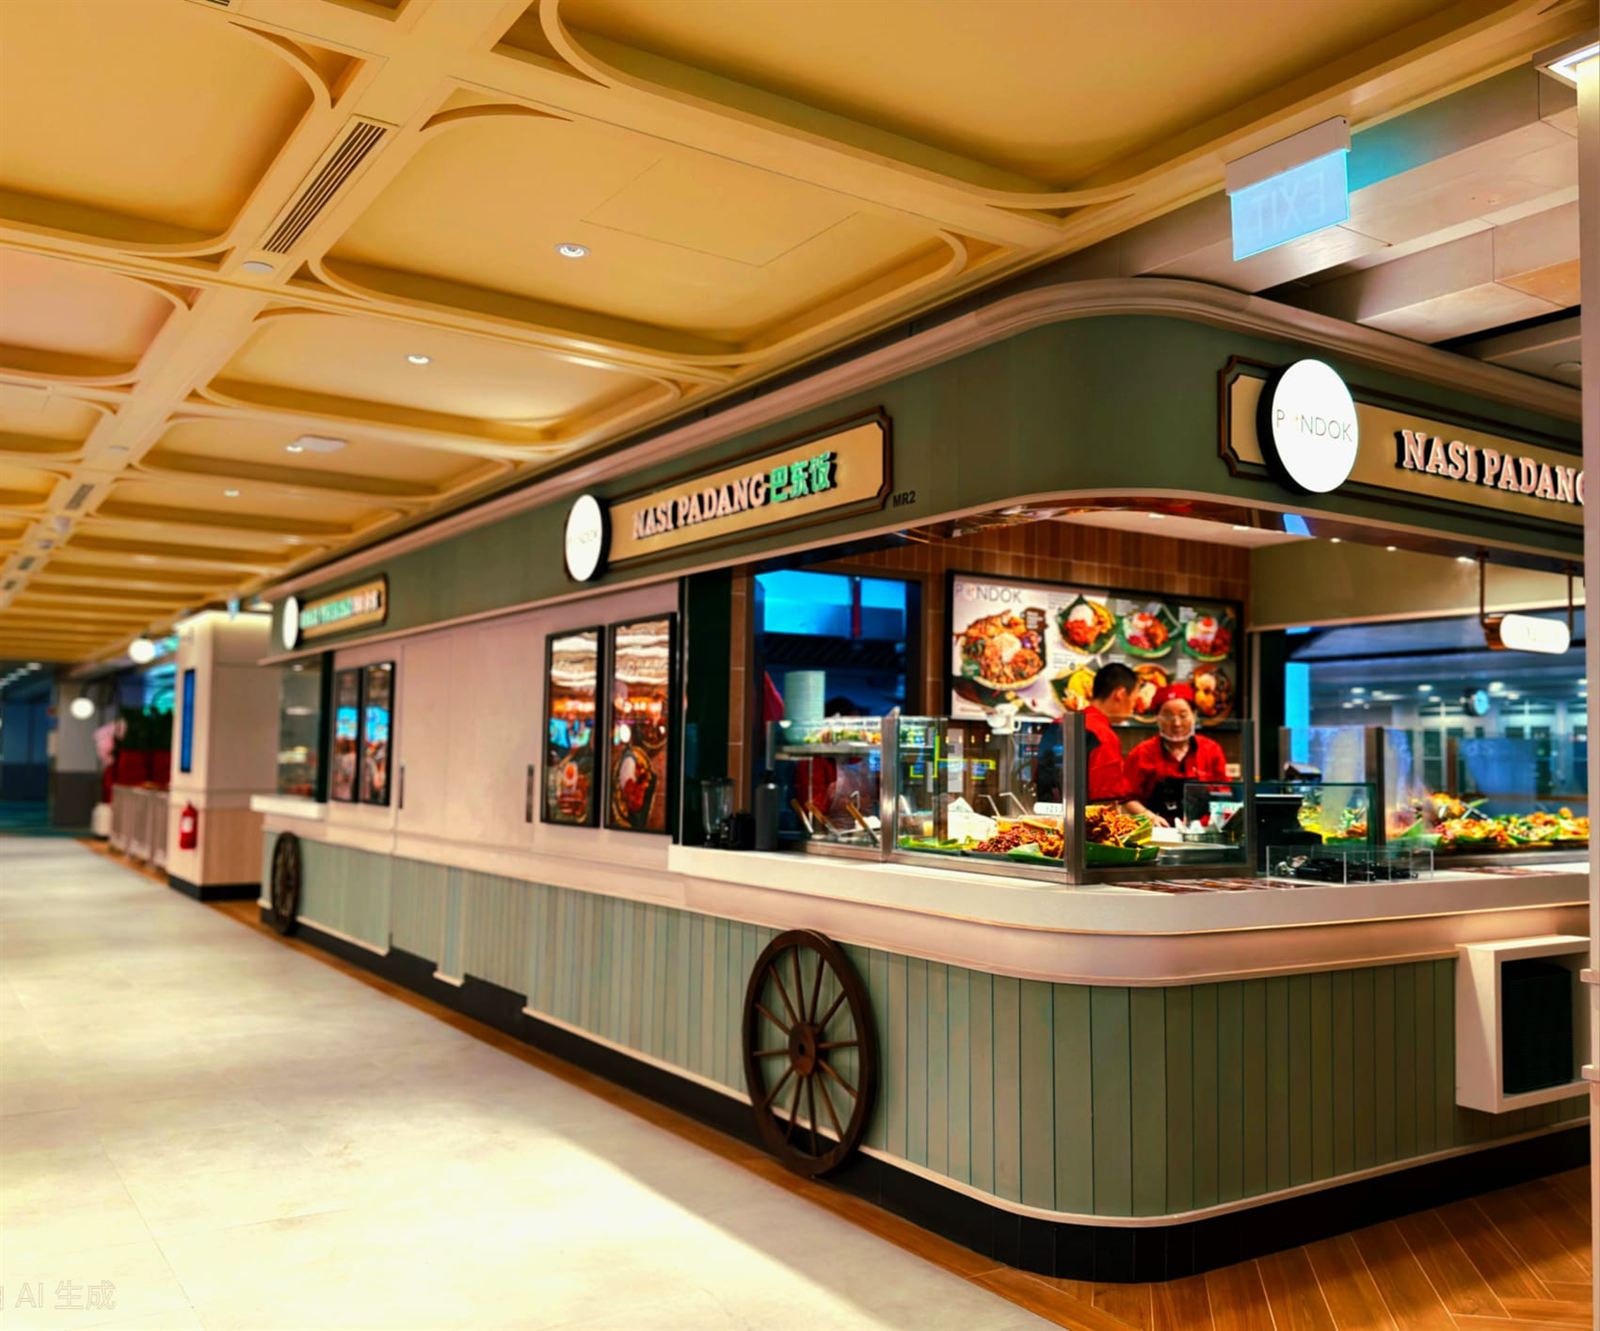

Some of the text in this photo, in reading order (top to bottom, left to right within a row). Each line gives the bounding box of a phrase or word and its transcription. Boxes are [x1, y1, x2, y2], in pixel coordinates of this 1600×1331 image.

[1277, 408, 1352, 442] PNDOK
[1402, 429, 1478, 483] NASI
[632, 499, 675, 540] NASI
[676, 472, 768, 528] PADANG
[893, 490, 916, 508] MR2
